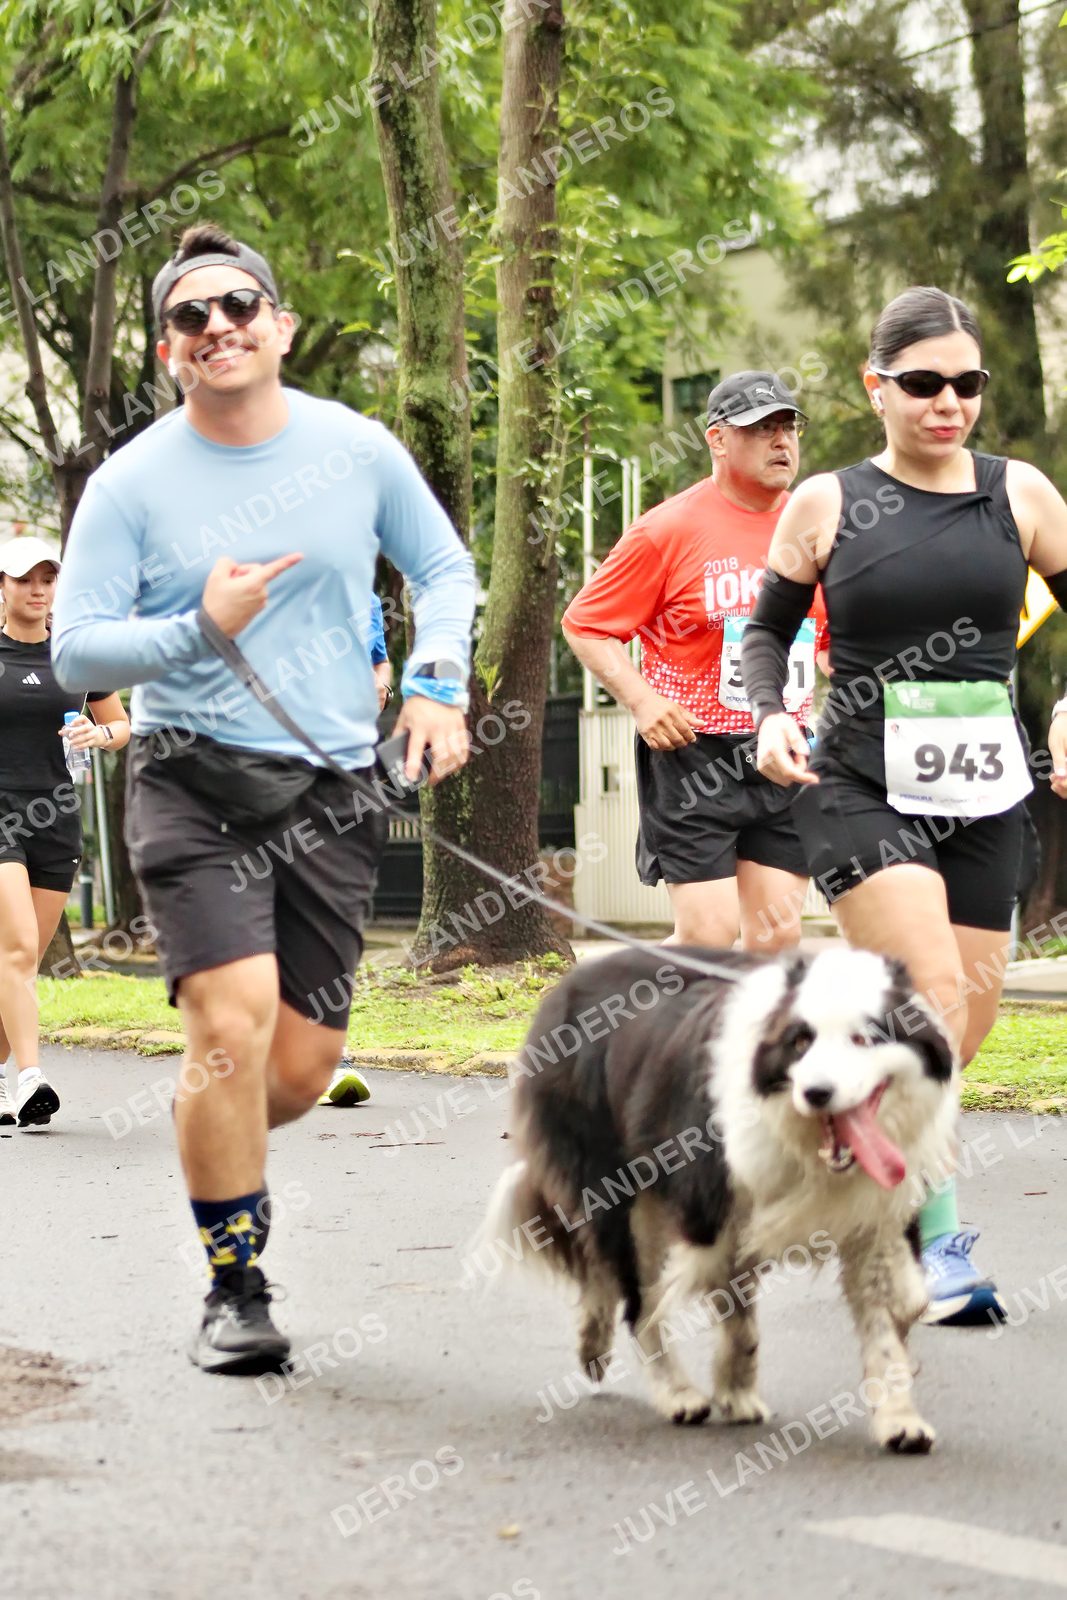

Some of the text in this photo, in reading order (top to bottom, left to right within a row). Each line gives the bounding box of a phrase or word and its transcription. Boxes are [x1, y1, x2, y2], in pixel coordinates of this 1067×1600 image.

[703, 556, 738, 577] 2018
[704, 568, 765, 612] 10K
[706, 606, 750, 622] TERNIUM
[914, 743, 1004, 784] 943
